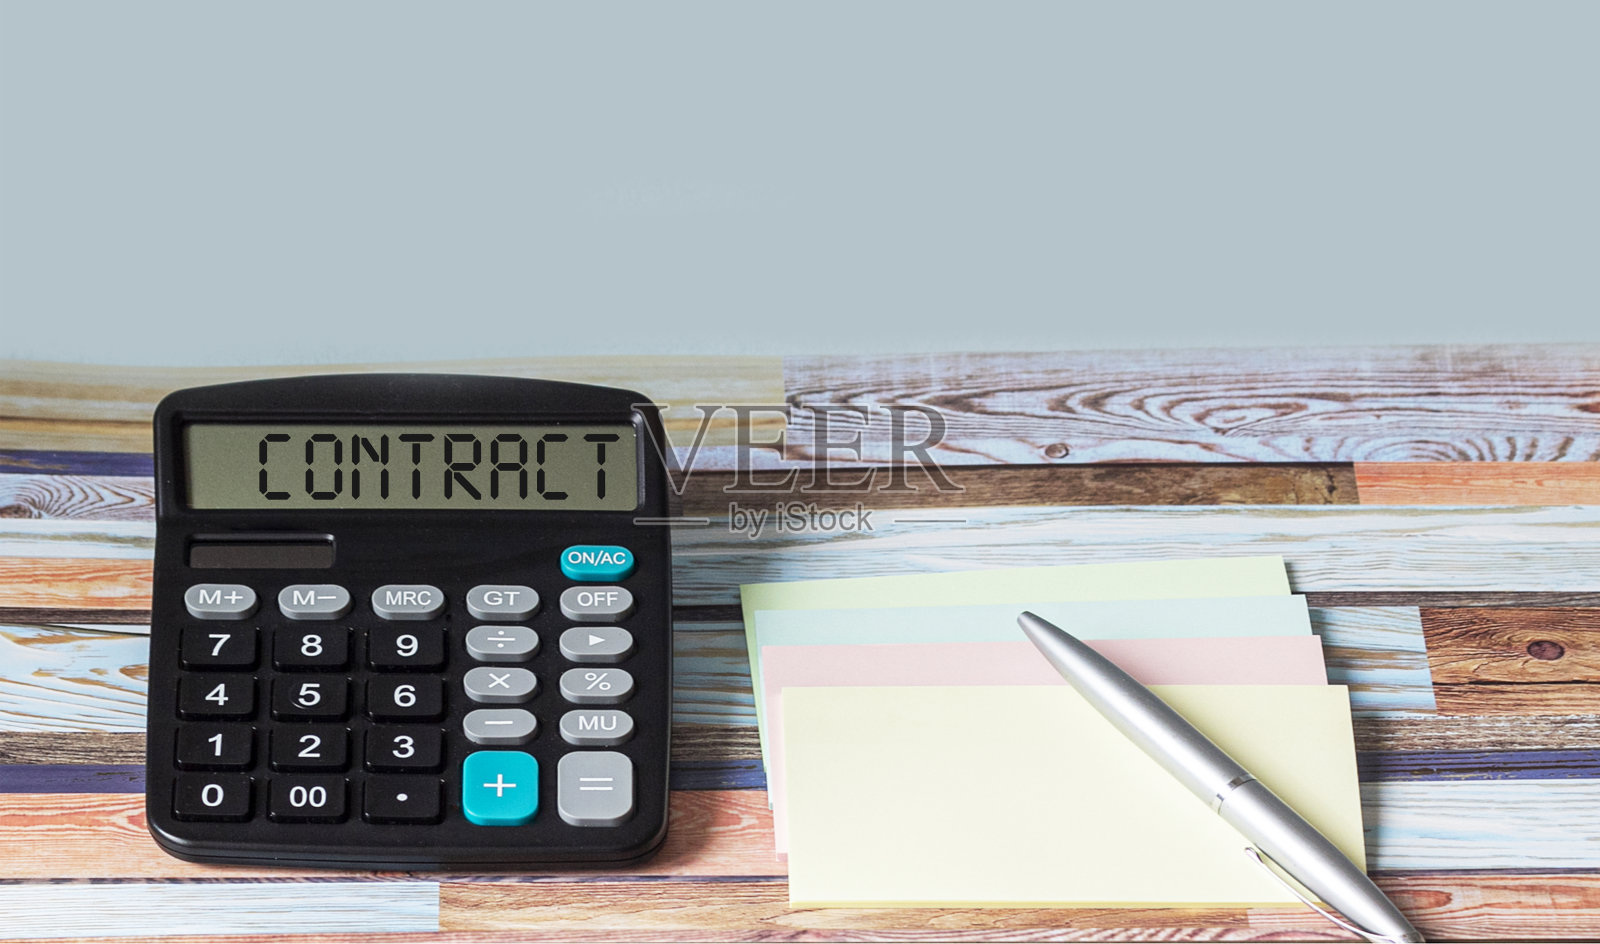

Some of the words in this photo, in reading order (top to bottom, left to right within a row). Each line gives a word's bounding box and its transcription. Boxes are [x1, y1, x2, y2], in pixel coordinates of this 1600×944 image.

[259, 433, 620, 500] CONTRACT
[568, 551, 626, 566] ON/AC
[199, 589, 244, 605] M+
[386, 590, 431, 606] MRC
[483, 590, 520, 606] GT
[577, 591, 619, 607] OFF
[208, 633, 231, 656] 7
[301, 634, 323, 657] 8
[396, 634, 418, 657] 9
[205, 683, 229, 706] 4
[299, 683, 321, 706] 5
[394, 684, 416, 707] 6
[578, 715, 617, 731] MU
[208, 733, 223, 756] 1
[298, 734, 321, 758] 2
[392, 735, 415, 759] 3
[201, 783, 224, 807] 0
[289, 785, 327, 808] 00
